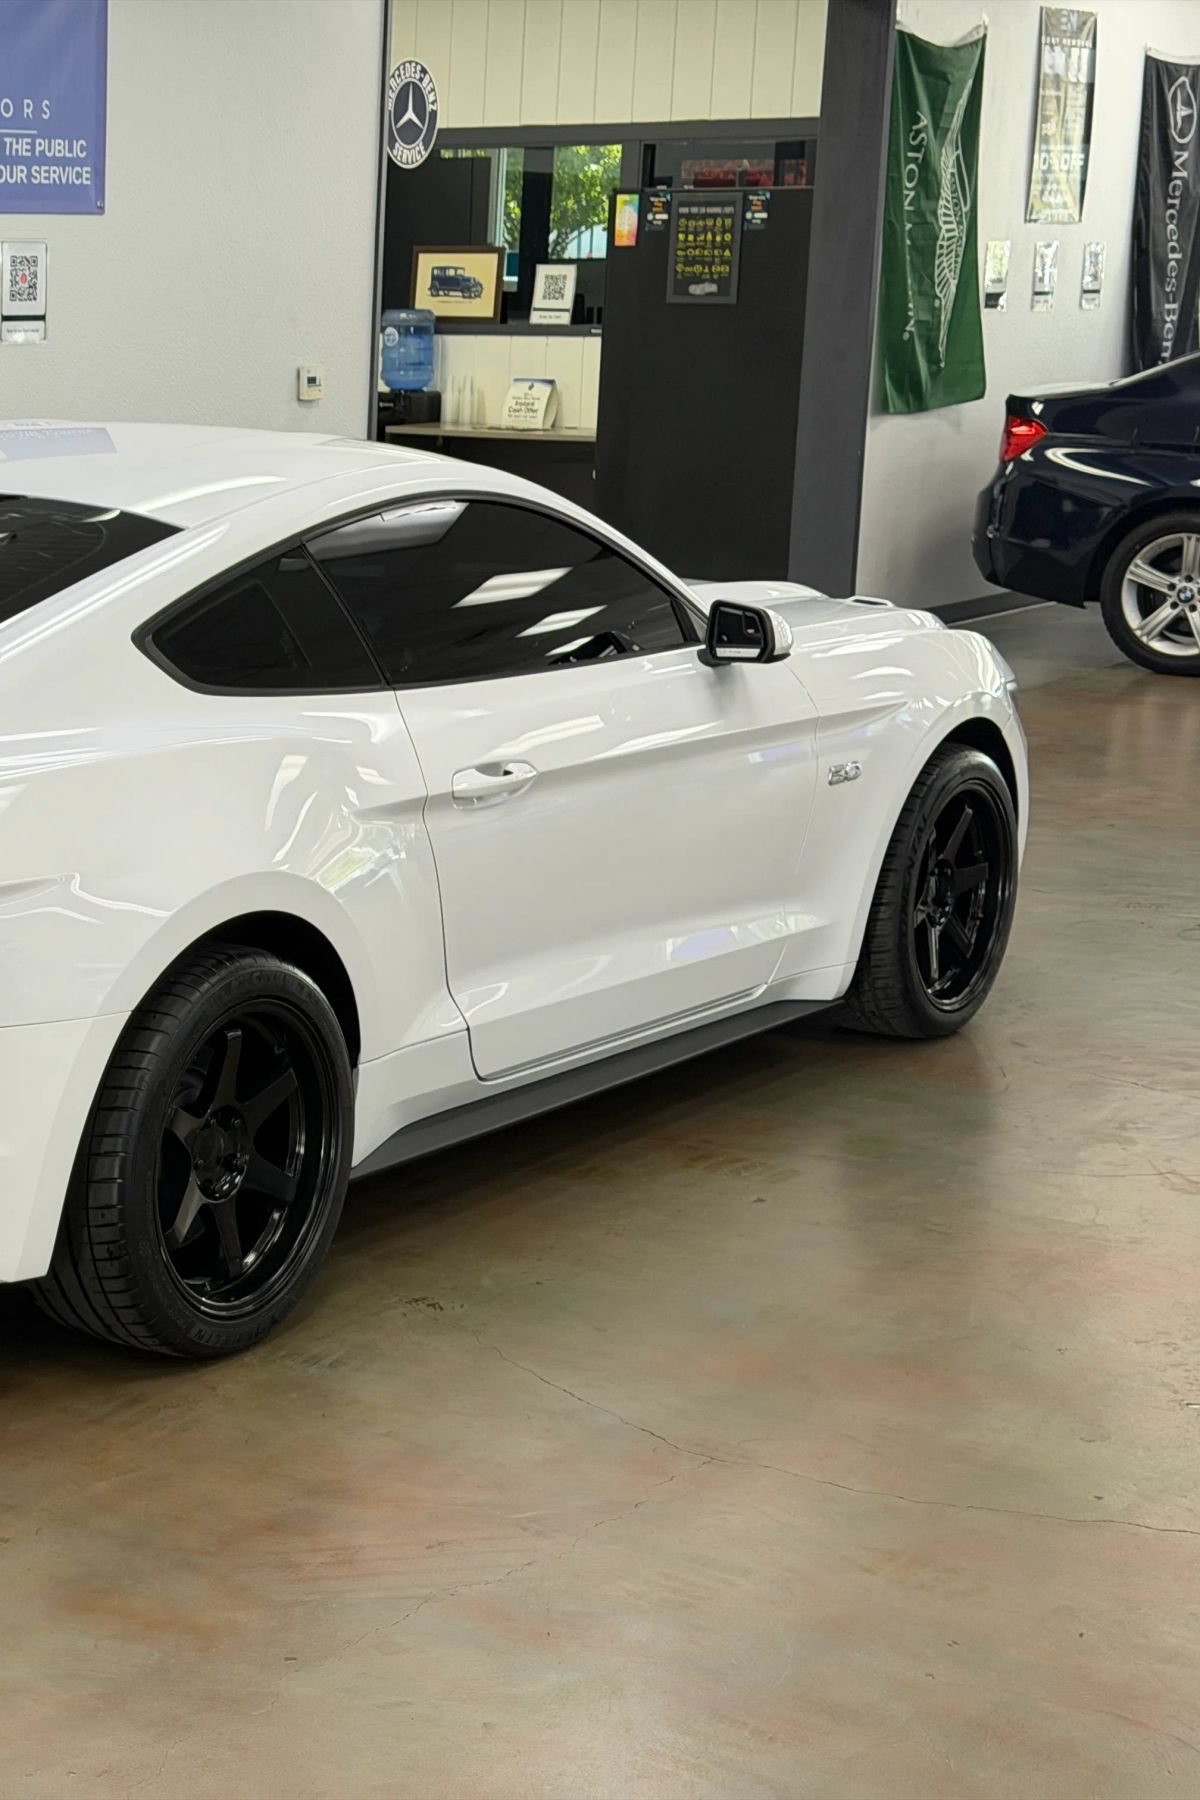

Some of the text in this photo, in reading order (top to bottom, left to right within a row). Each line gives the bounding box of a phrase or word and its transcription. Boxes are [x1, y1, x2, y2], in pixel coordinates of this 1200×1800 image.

[4, 137, 31, 157] THE
[35, 138, 87, 158] PUBLIC
[392, 141, 427, 165] SERVICE
[903, 111, 928, 211] ASTON
[31, 165, 91, 185] SERVICE
